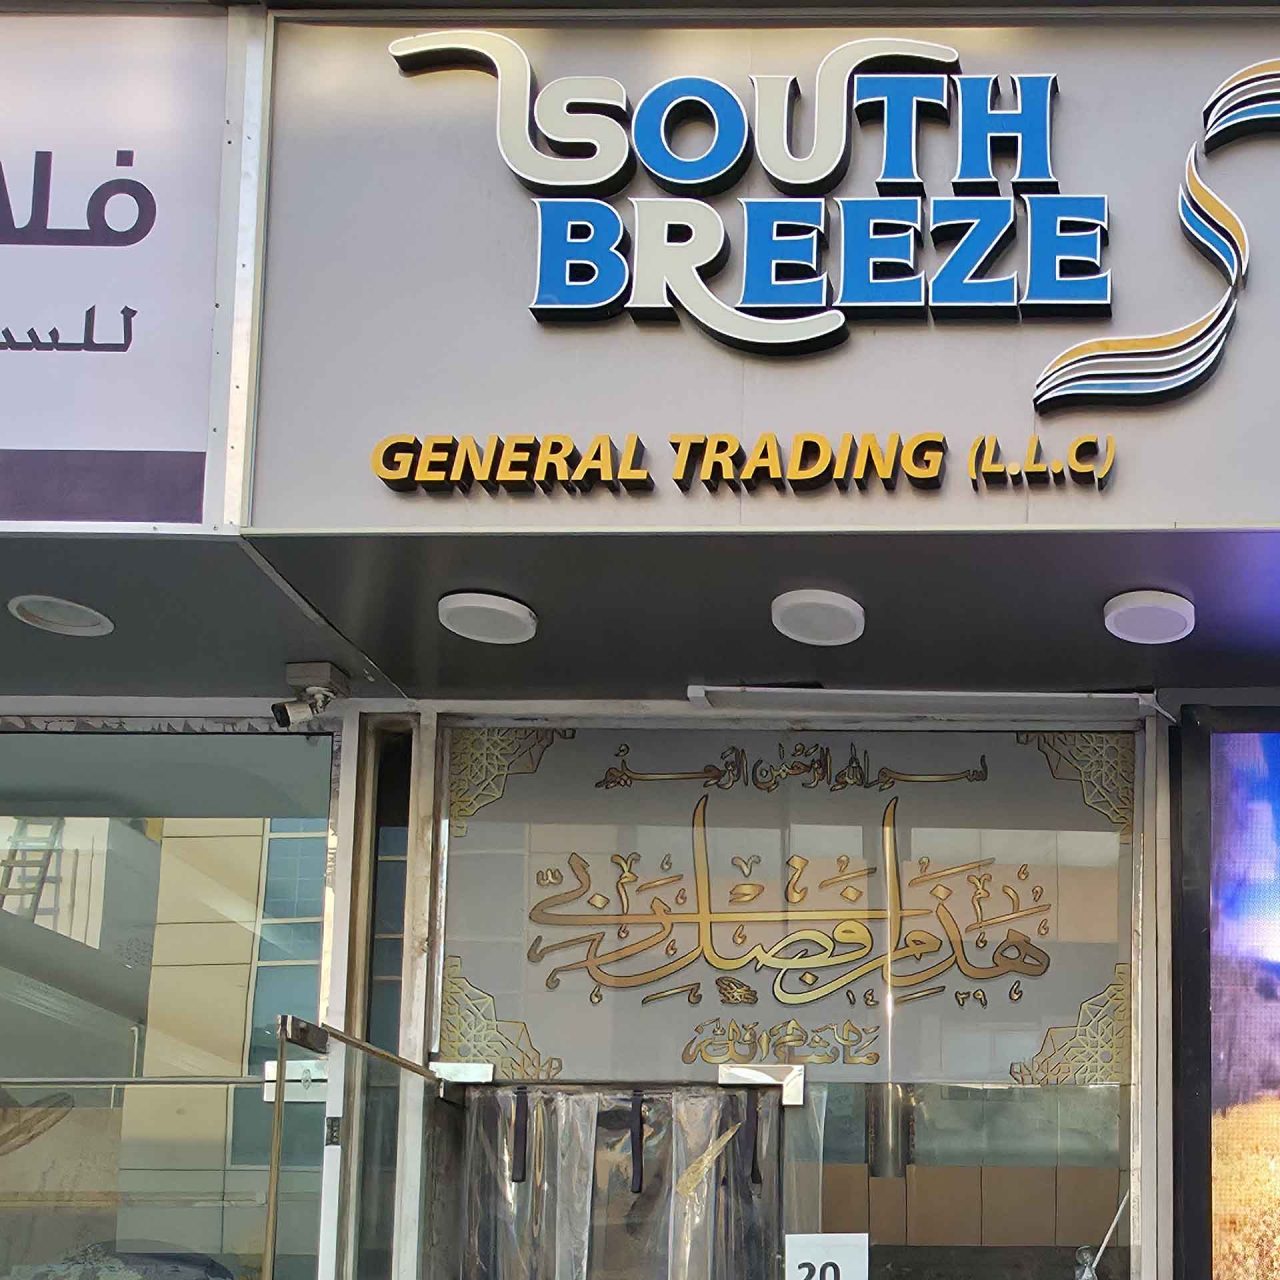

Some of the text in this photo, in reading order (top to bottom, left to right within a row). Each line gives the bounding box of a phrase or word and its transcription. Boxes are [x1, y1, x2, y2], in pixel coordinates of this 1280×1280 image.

[389, 30, 1058, 186] SOUTH
[531, 195, 1113, 345] BREEZE
[371, 433, 1117, 484] GENERAL TRADING (L.L.C)
